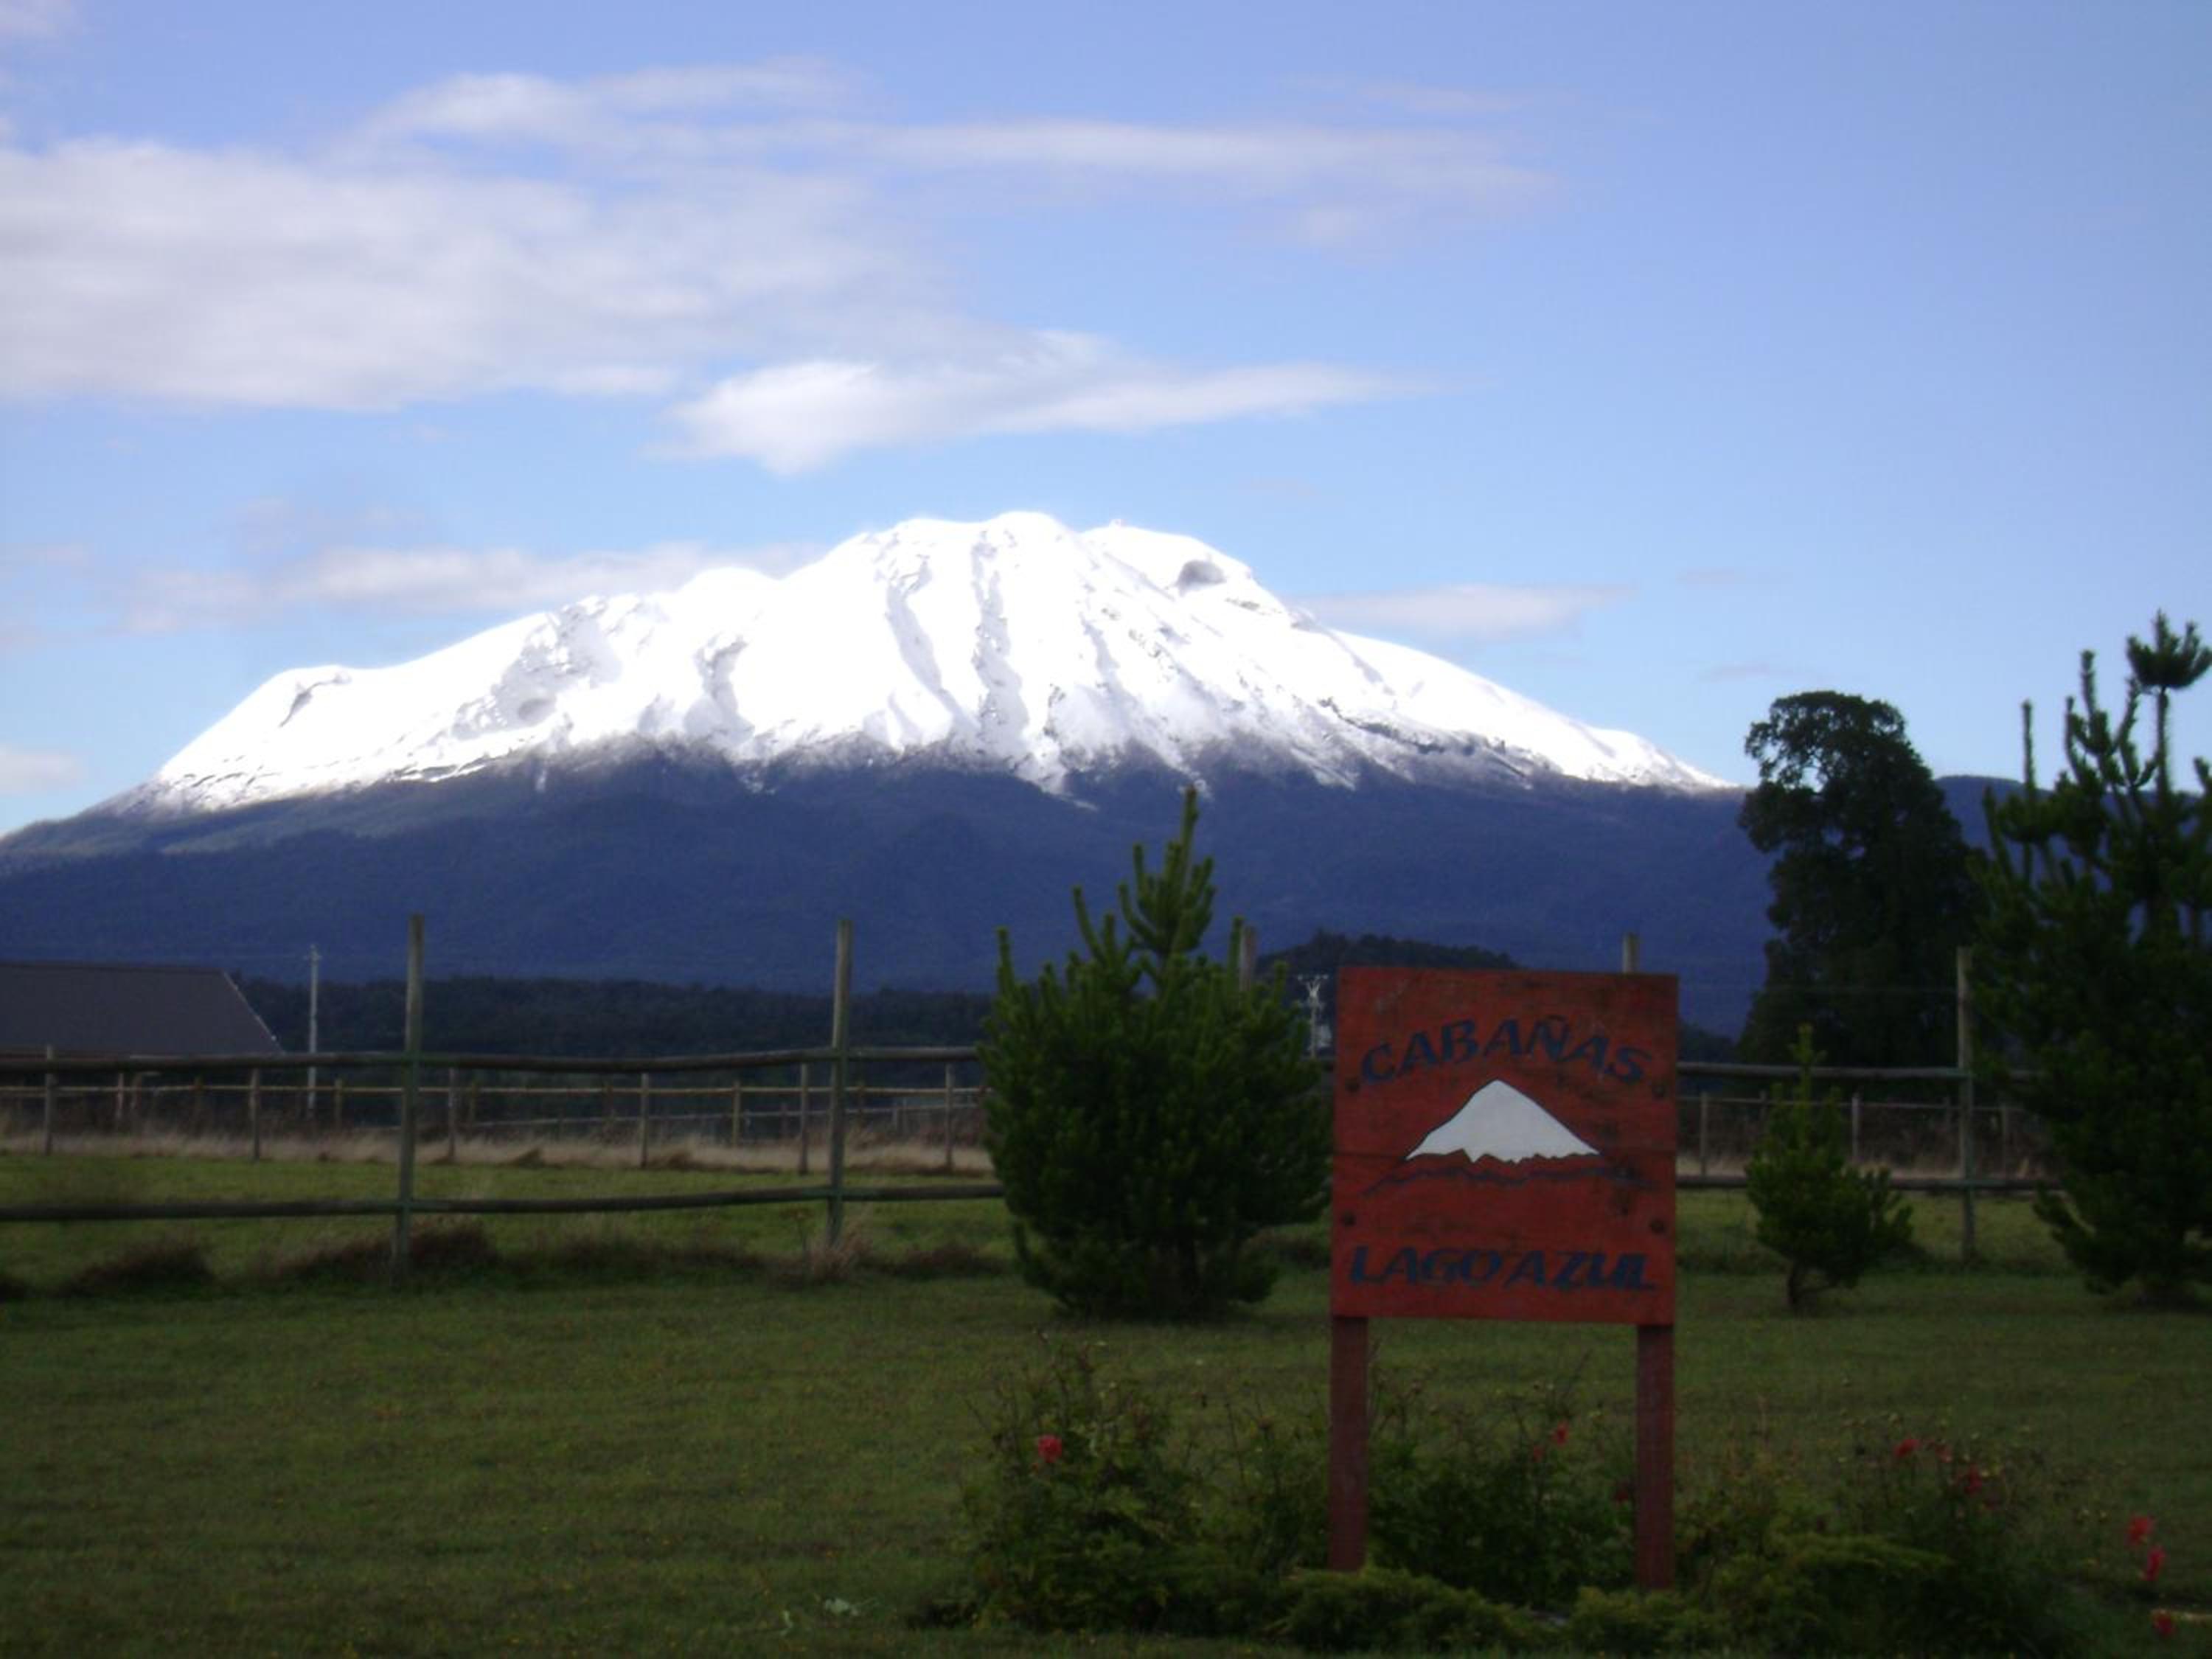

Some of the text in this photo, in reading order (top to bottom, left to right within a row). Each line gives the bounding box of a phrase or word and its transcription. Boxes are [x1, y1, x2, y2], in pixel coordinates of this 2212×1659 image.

[1361, 1015, 1652, 1084] CABAÑAS
[1350, 1246, 1658, 1292] LAGO AZUL
